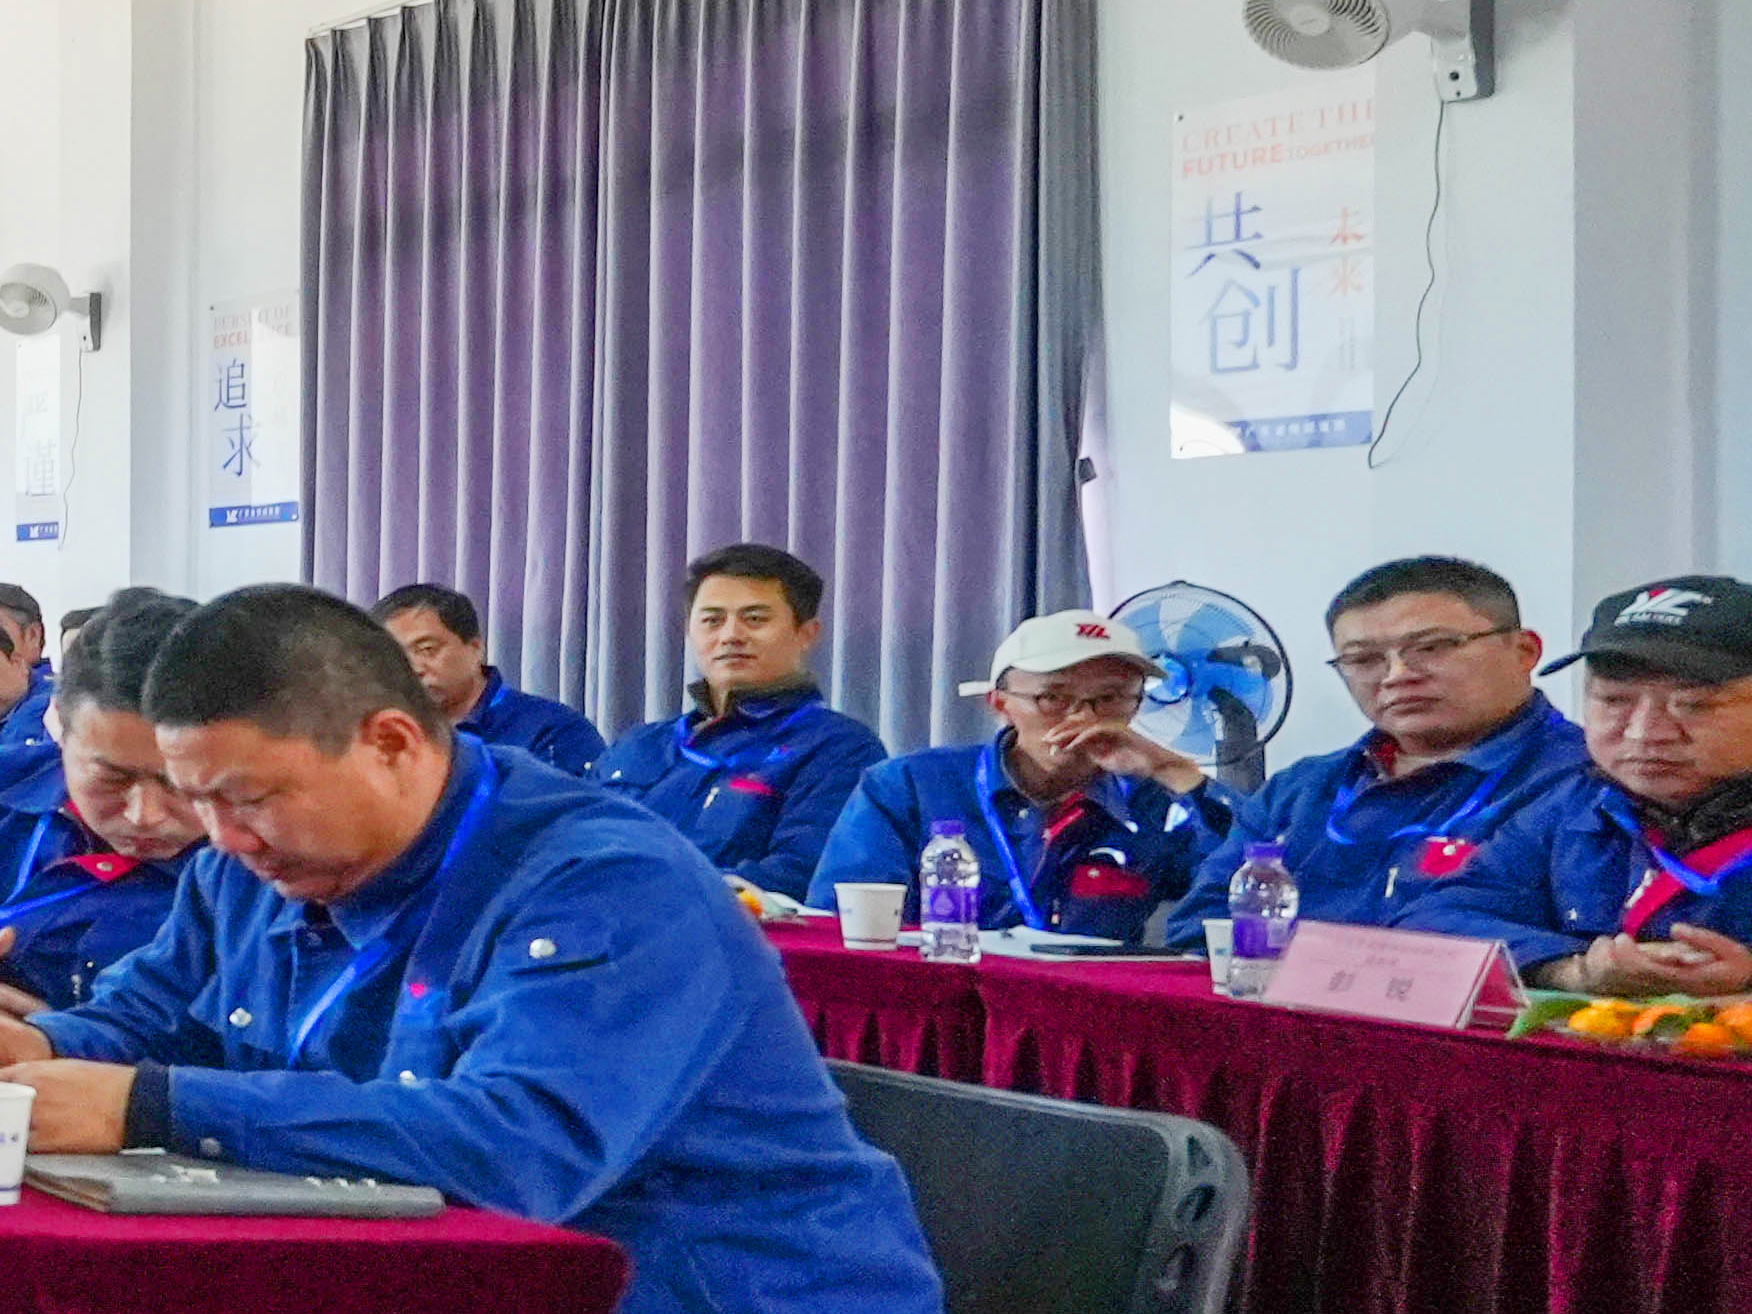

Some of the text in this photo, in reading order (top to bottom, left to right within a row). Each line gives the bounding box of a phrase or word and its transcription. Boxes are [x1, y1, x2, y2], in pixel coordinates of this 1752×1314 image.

[1183, 109, 1304, 152] CREATE
[1182, 142, 1284, 179] FUTURE
[1185, 190, 1301, 374] 共创
